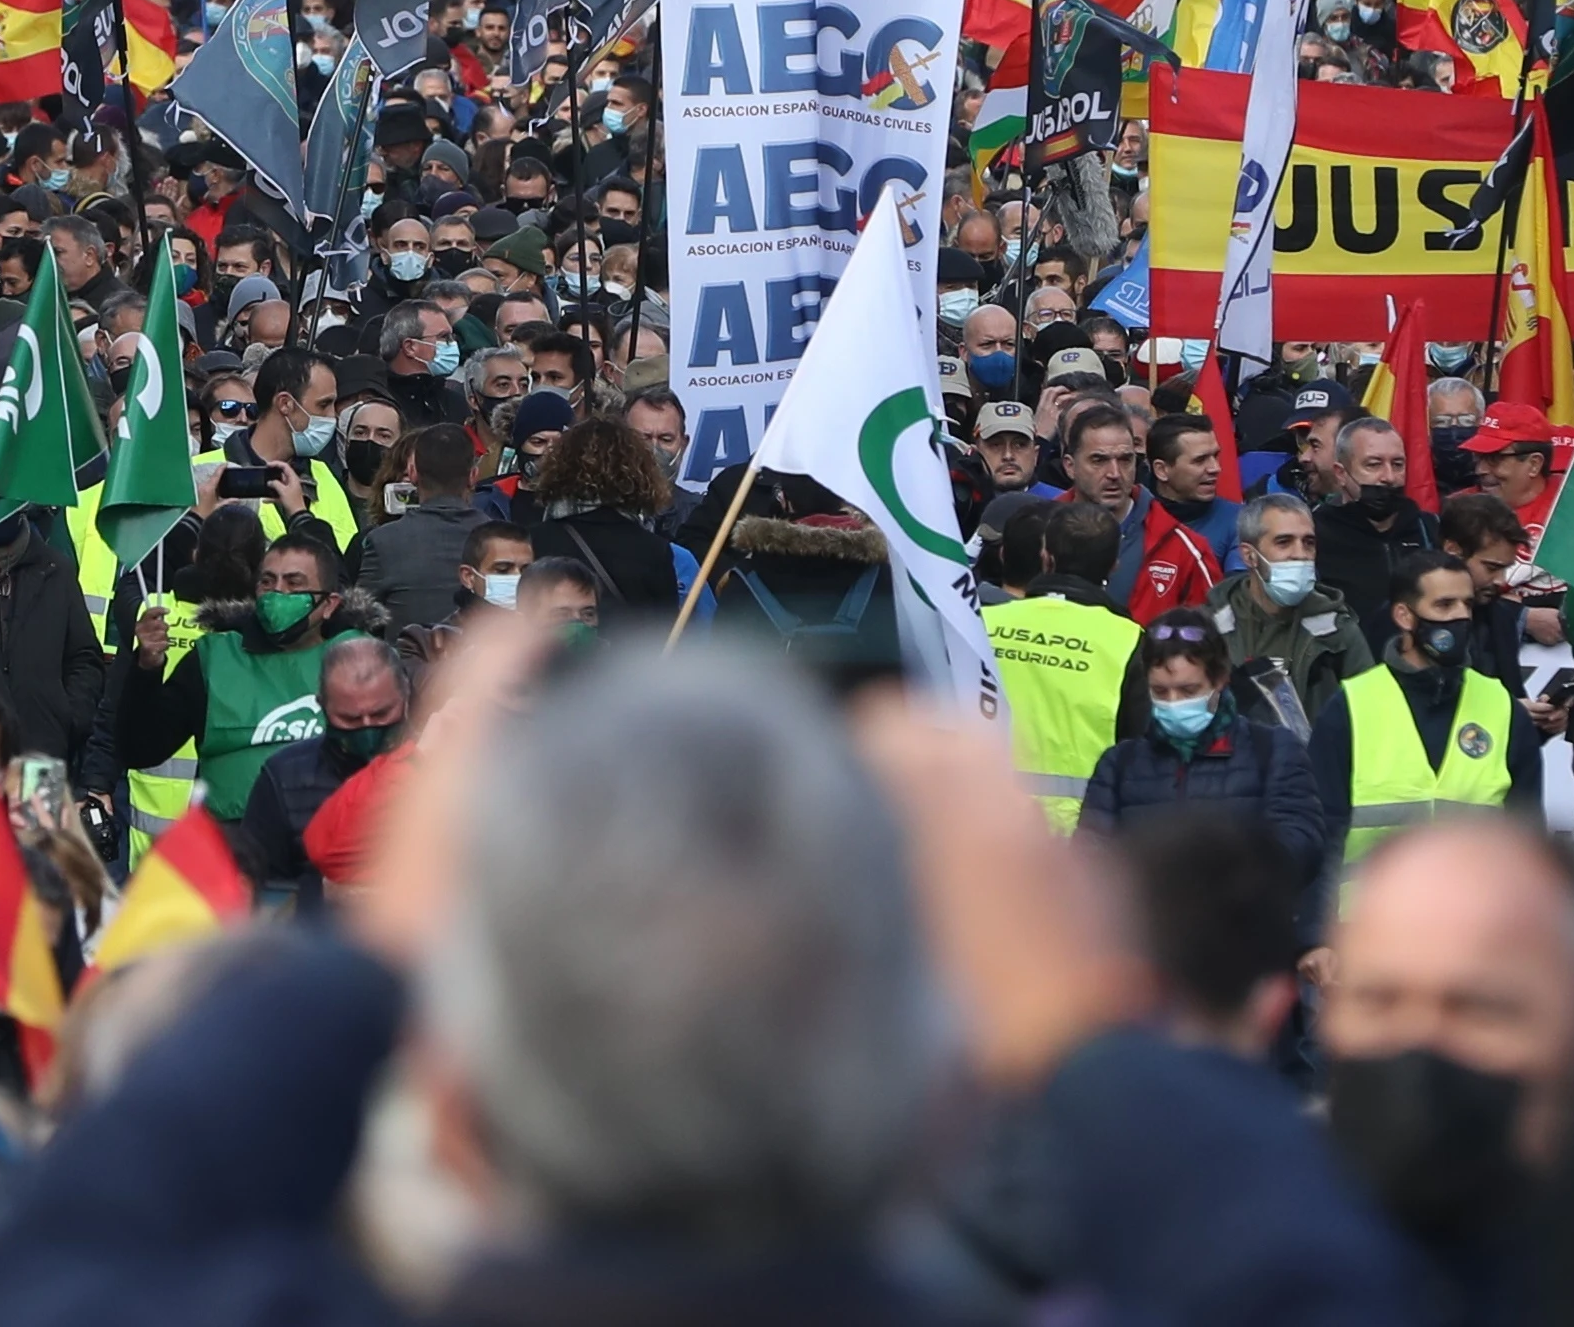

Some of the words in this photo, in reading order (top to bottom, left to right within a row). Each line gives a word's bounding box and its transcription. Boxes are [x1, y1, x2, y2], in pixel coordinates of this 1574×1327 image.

[682, 105, 768, 119] ASOCIACION
[773, 100, 818, 115] ESPAÑ
[822, 105, 881, 126] GUARDIAS
[883, 117, 933, 134] CIVILES
[687, 242, 773, 257] ASOCIACION
[776, 233, 821, 249] ESPAÑ
[1060, 352, 1080, 363] CEP
[688, 372, 774, 387] ASOCIACION
[1297, 391, 1327, 406] SUP
[995, 403, 1021, 418] CEP
[987, 626, 1094, 654] JUSAPOL
